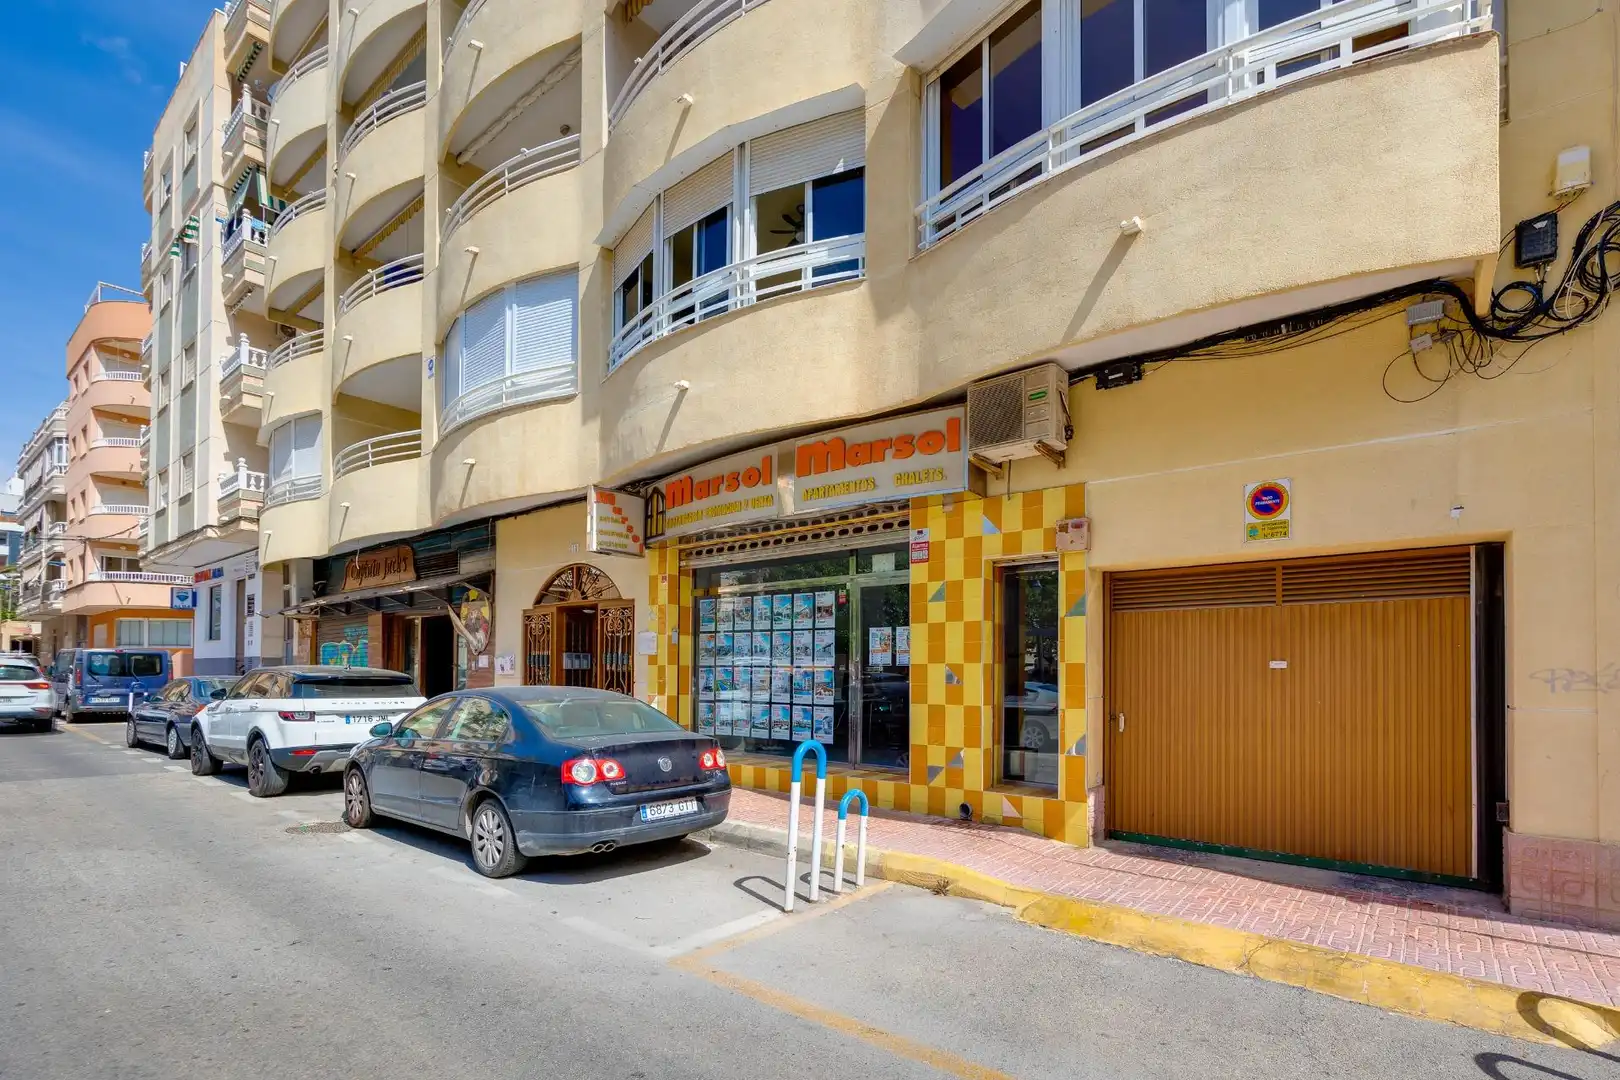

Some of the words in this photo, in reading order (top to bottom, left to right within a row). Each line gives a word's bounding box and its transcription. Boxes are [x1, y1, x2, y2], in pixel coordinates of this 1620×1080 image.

[795, 417, 961, 478] Marsol
[665, 455, 773, 511] Marsol
[352, 714, 374, 723] 1716
[649, 803, 674, 817] 6873
